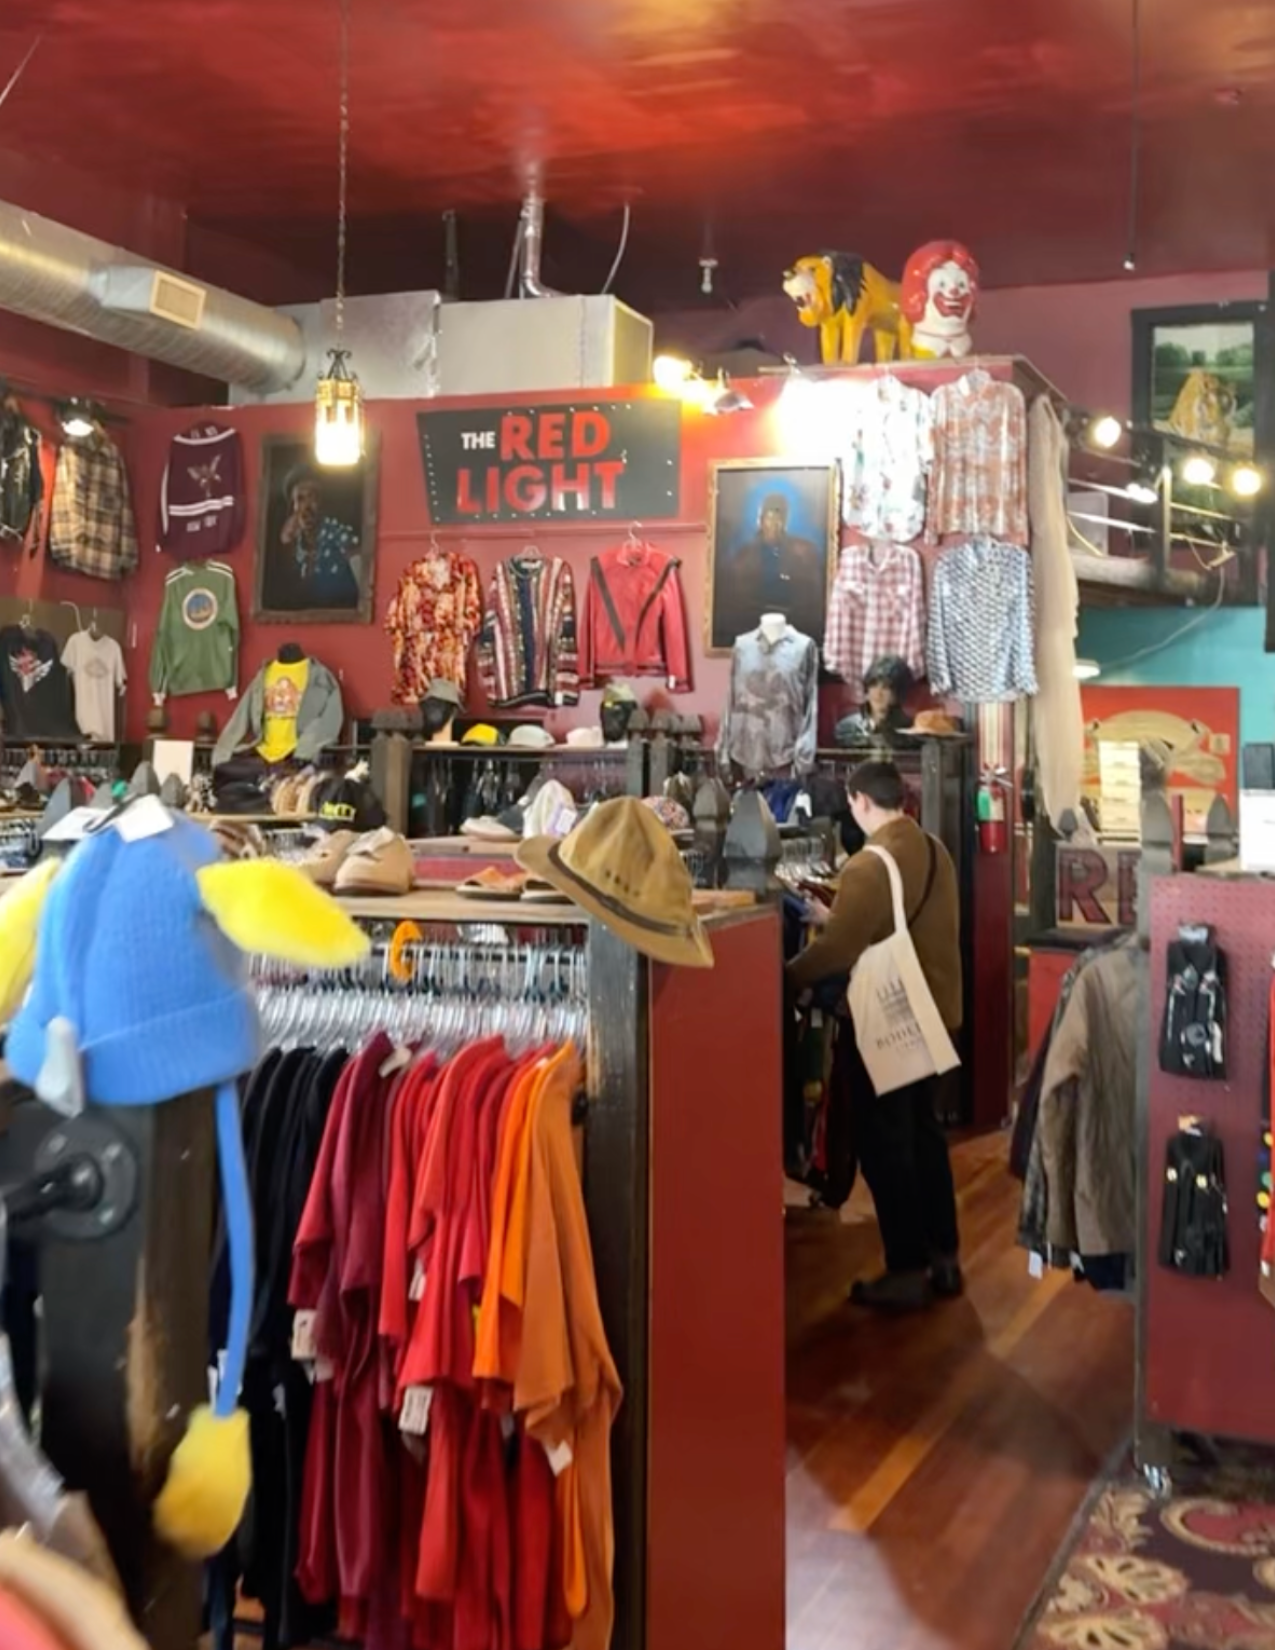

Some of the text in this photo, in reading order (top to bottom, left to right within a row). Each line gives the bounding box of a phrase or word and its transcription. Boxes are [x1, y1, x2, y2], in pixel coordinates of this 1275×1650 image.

[461, 411, 611, 461] THE RED
[456, 461, 625, 513] LIGHT
